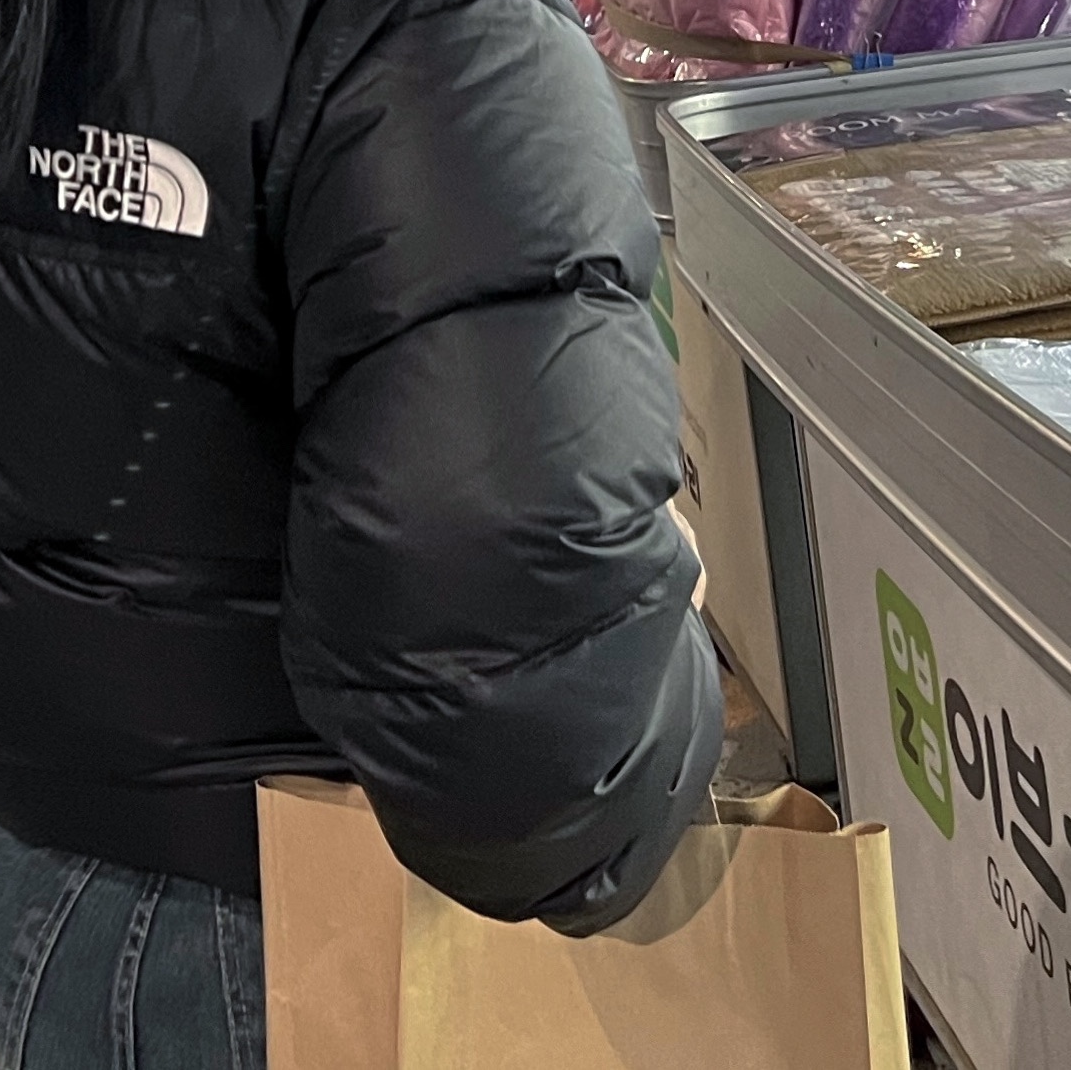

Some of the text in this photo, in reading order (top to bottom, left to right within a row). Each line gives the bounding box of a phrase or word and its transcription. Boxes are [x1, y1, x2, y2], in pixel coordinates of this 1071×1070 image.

[78, 124, 147, 162] THE
[796, 114, 904, 138] OOM
[29, 145, 147, 192] NORTH
[57, 179, 144, 224] FACE
[944, 677, 1071, 914] 이브
[987, 856, 1054, 979] GOOD
